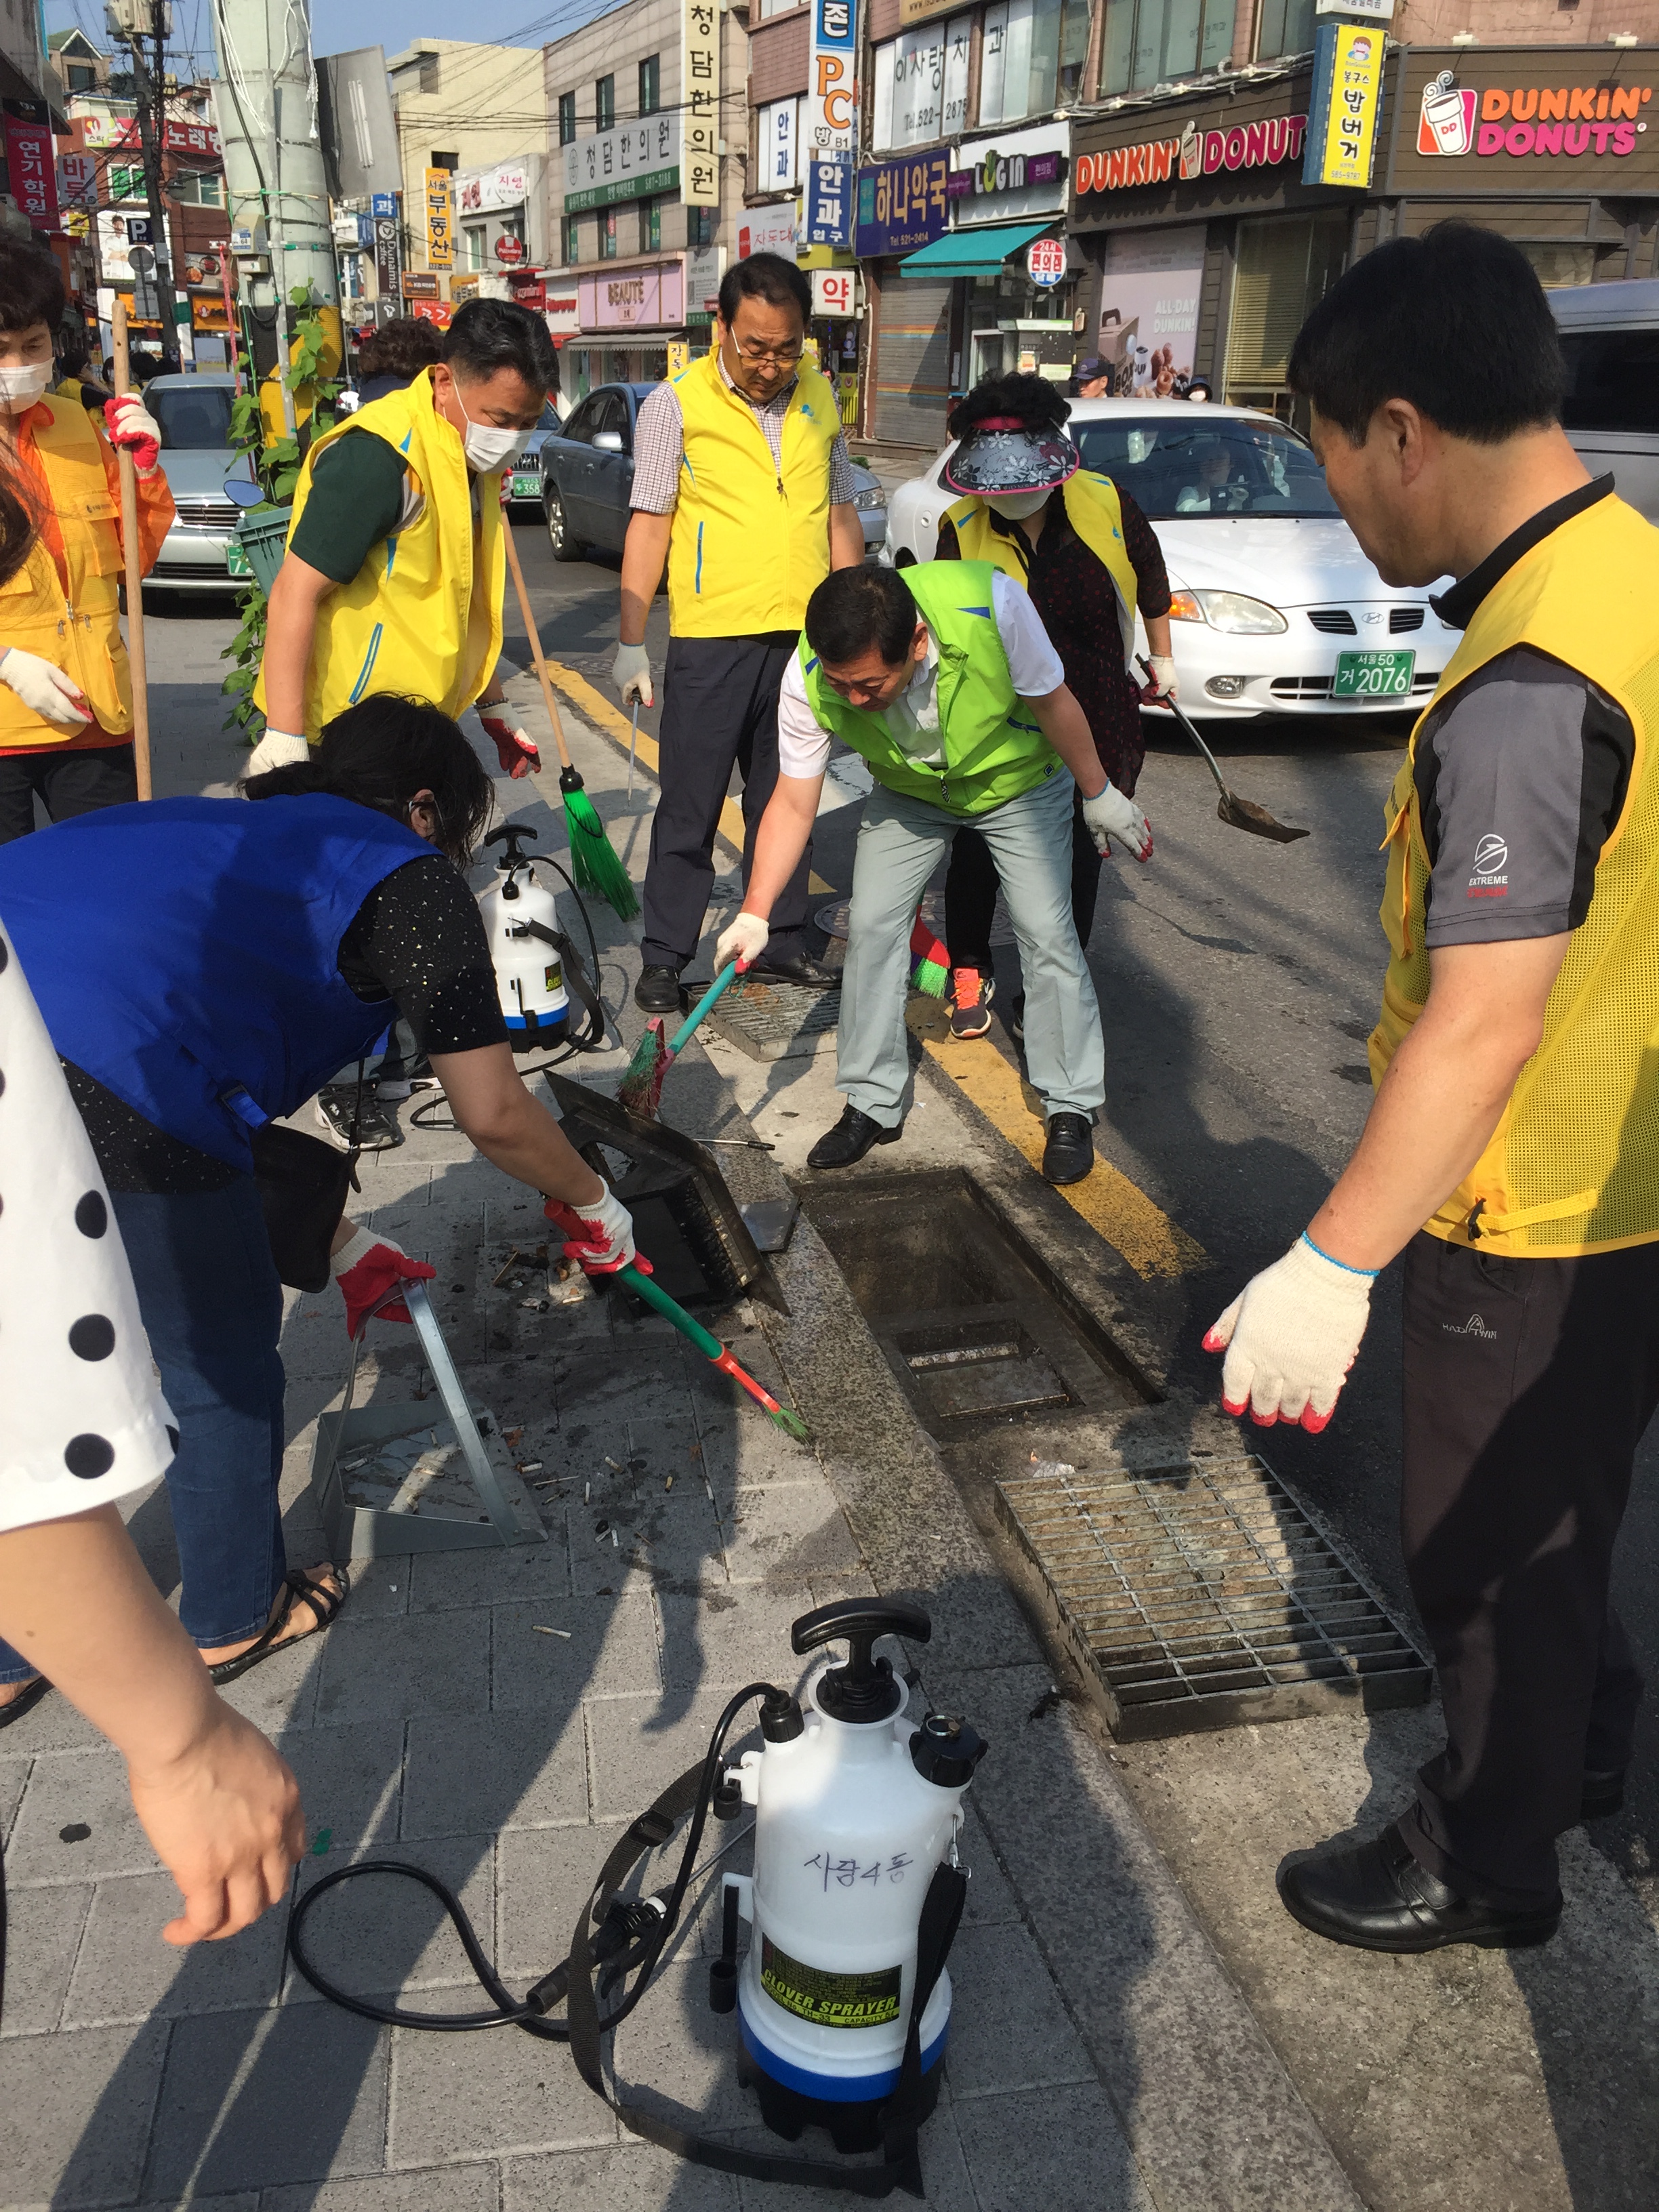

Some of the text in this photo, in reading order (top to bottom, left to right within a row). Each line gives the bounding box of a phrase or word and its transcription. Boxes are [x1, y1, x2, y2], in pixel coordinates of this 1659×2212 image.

[895, 24, 1004, 91] 이사랑치과
[1344, 70, 1370, 84] 봉구스
[691, 4, 714, 194] 청담한의원
[1481, 87, 1652, 121] DUNKIN'
[835, 137, 848, 148] B1
[1340, 89, 1366, 159] 밥버거
[1441, 122, 1457, 136] DD
[1477, 122, 1635, 156] DONUTS
[586, 119, 670, 180] 청담한의원
[777, 111, 790, 178] 안과
[1203, 114, 1309, 174] DONUT
[18, 140, 47, 216] 연기학원
[63, 159, 89, 204] 바둑
[428, 179, 447, 191] 서울
[499, 175, 523, 189] 지영
[1076, 138, 1181, 195] DUNKIN'
[815, 165, 844, 228] 안과
[876, 160, 947, 226] 하나약국
[429, 194, 449, 258] 부동산
[822, 278, 849, 311] 약
[1155, 298, 1197, 315] ALL-DAY
[1153, 317, 1196, 334] DUNKIN!
[1357, 654, 1395, 665] 서울50
[1469, 876, 1509, 886] EXTREME
[764, 1968, 815, 2009] CLOVER
[819, 1996, 897, 2016] SPRAYER
[802, 2007, 831, 2022] TH-33
[844, 2013, 882, 2024] CAPACITY
